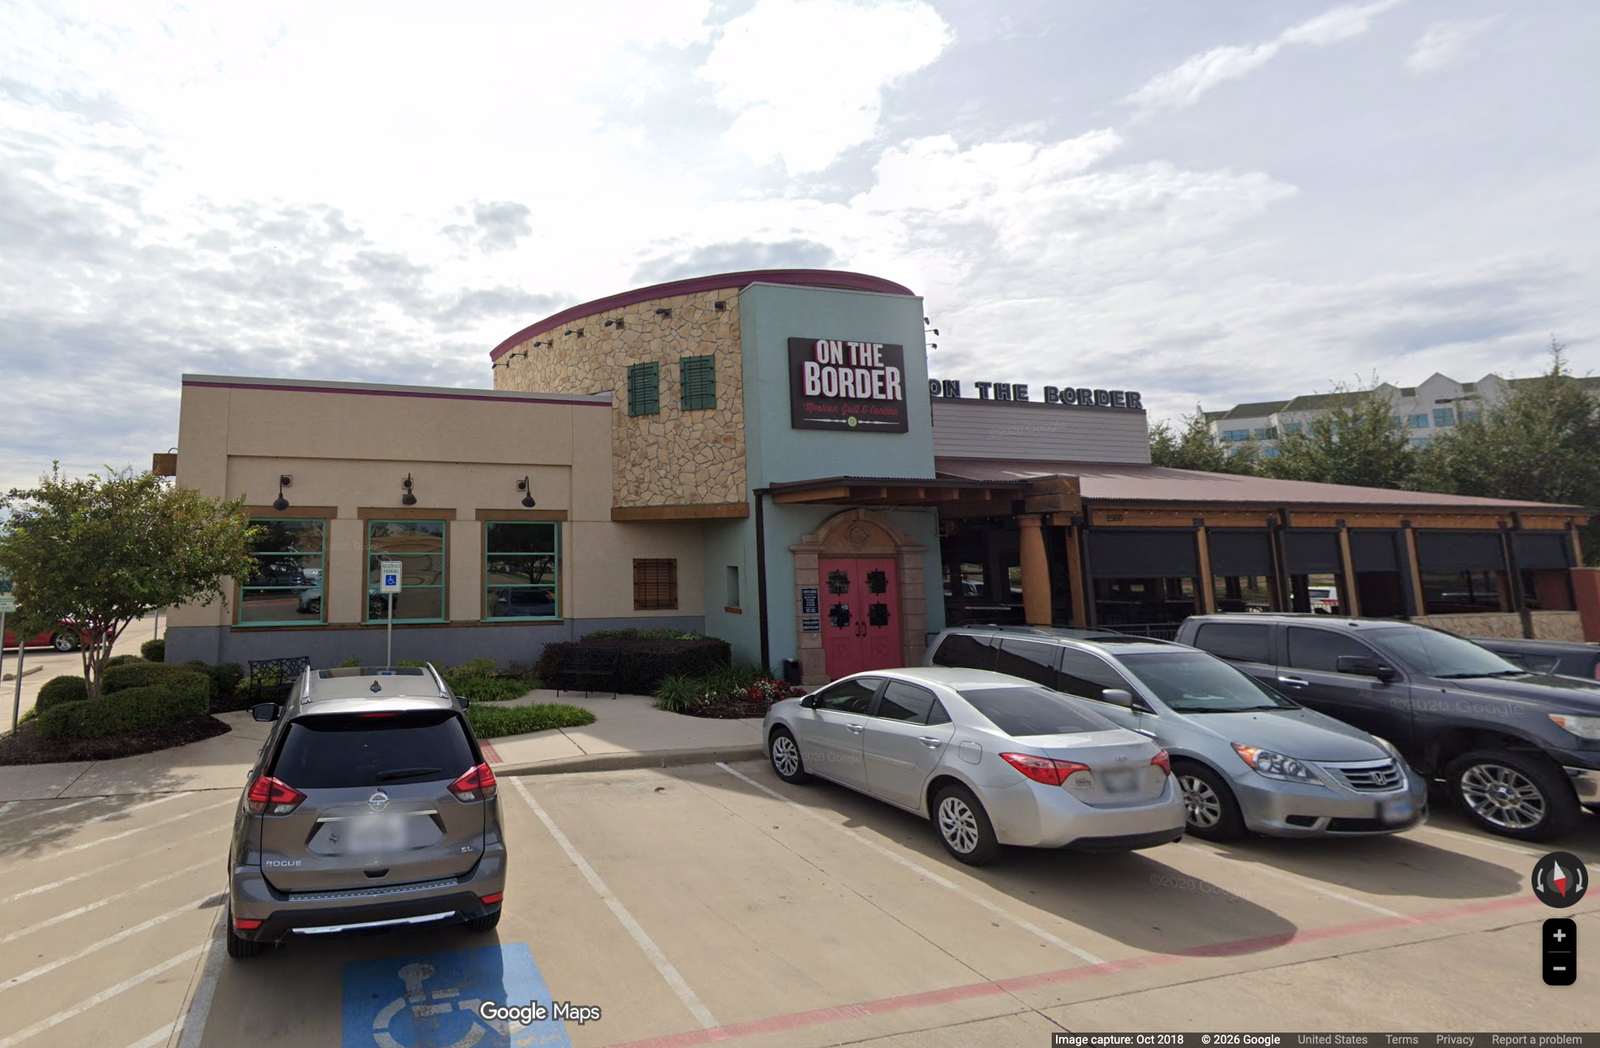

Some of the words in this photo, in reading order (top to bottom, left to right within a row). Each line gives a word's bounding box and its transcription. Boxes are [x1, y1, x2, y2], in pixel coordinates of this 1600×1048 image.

[815, 339, 843, 365] ON
[847, 342, 884, 367] THE
[803, 361, 902, 400] BORDER
[929, 379, 960, 398] ON
[975, 381, 1029, 401] THE
[1044, 385, 1143, 408] BORDER
[803, 402, 838, 413] Mexican
[841, 403, 859, 416] Grill
[861, 405, 868, 414] &
[870, 405, 899, 416] Cantina
[266, 860, 302, 868] ROGUE
